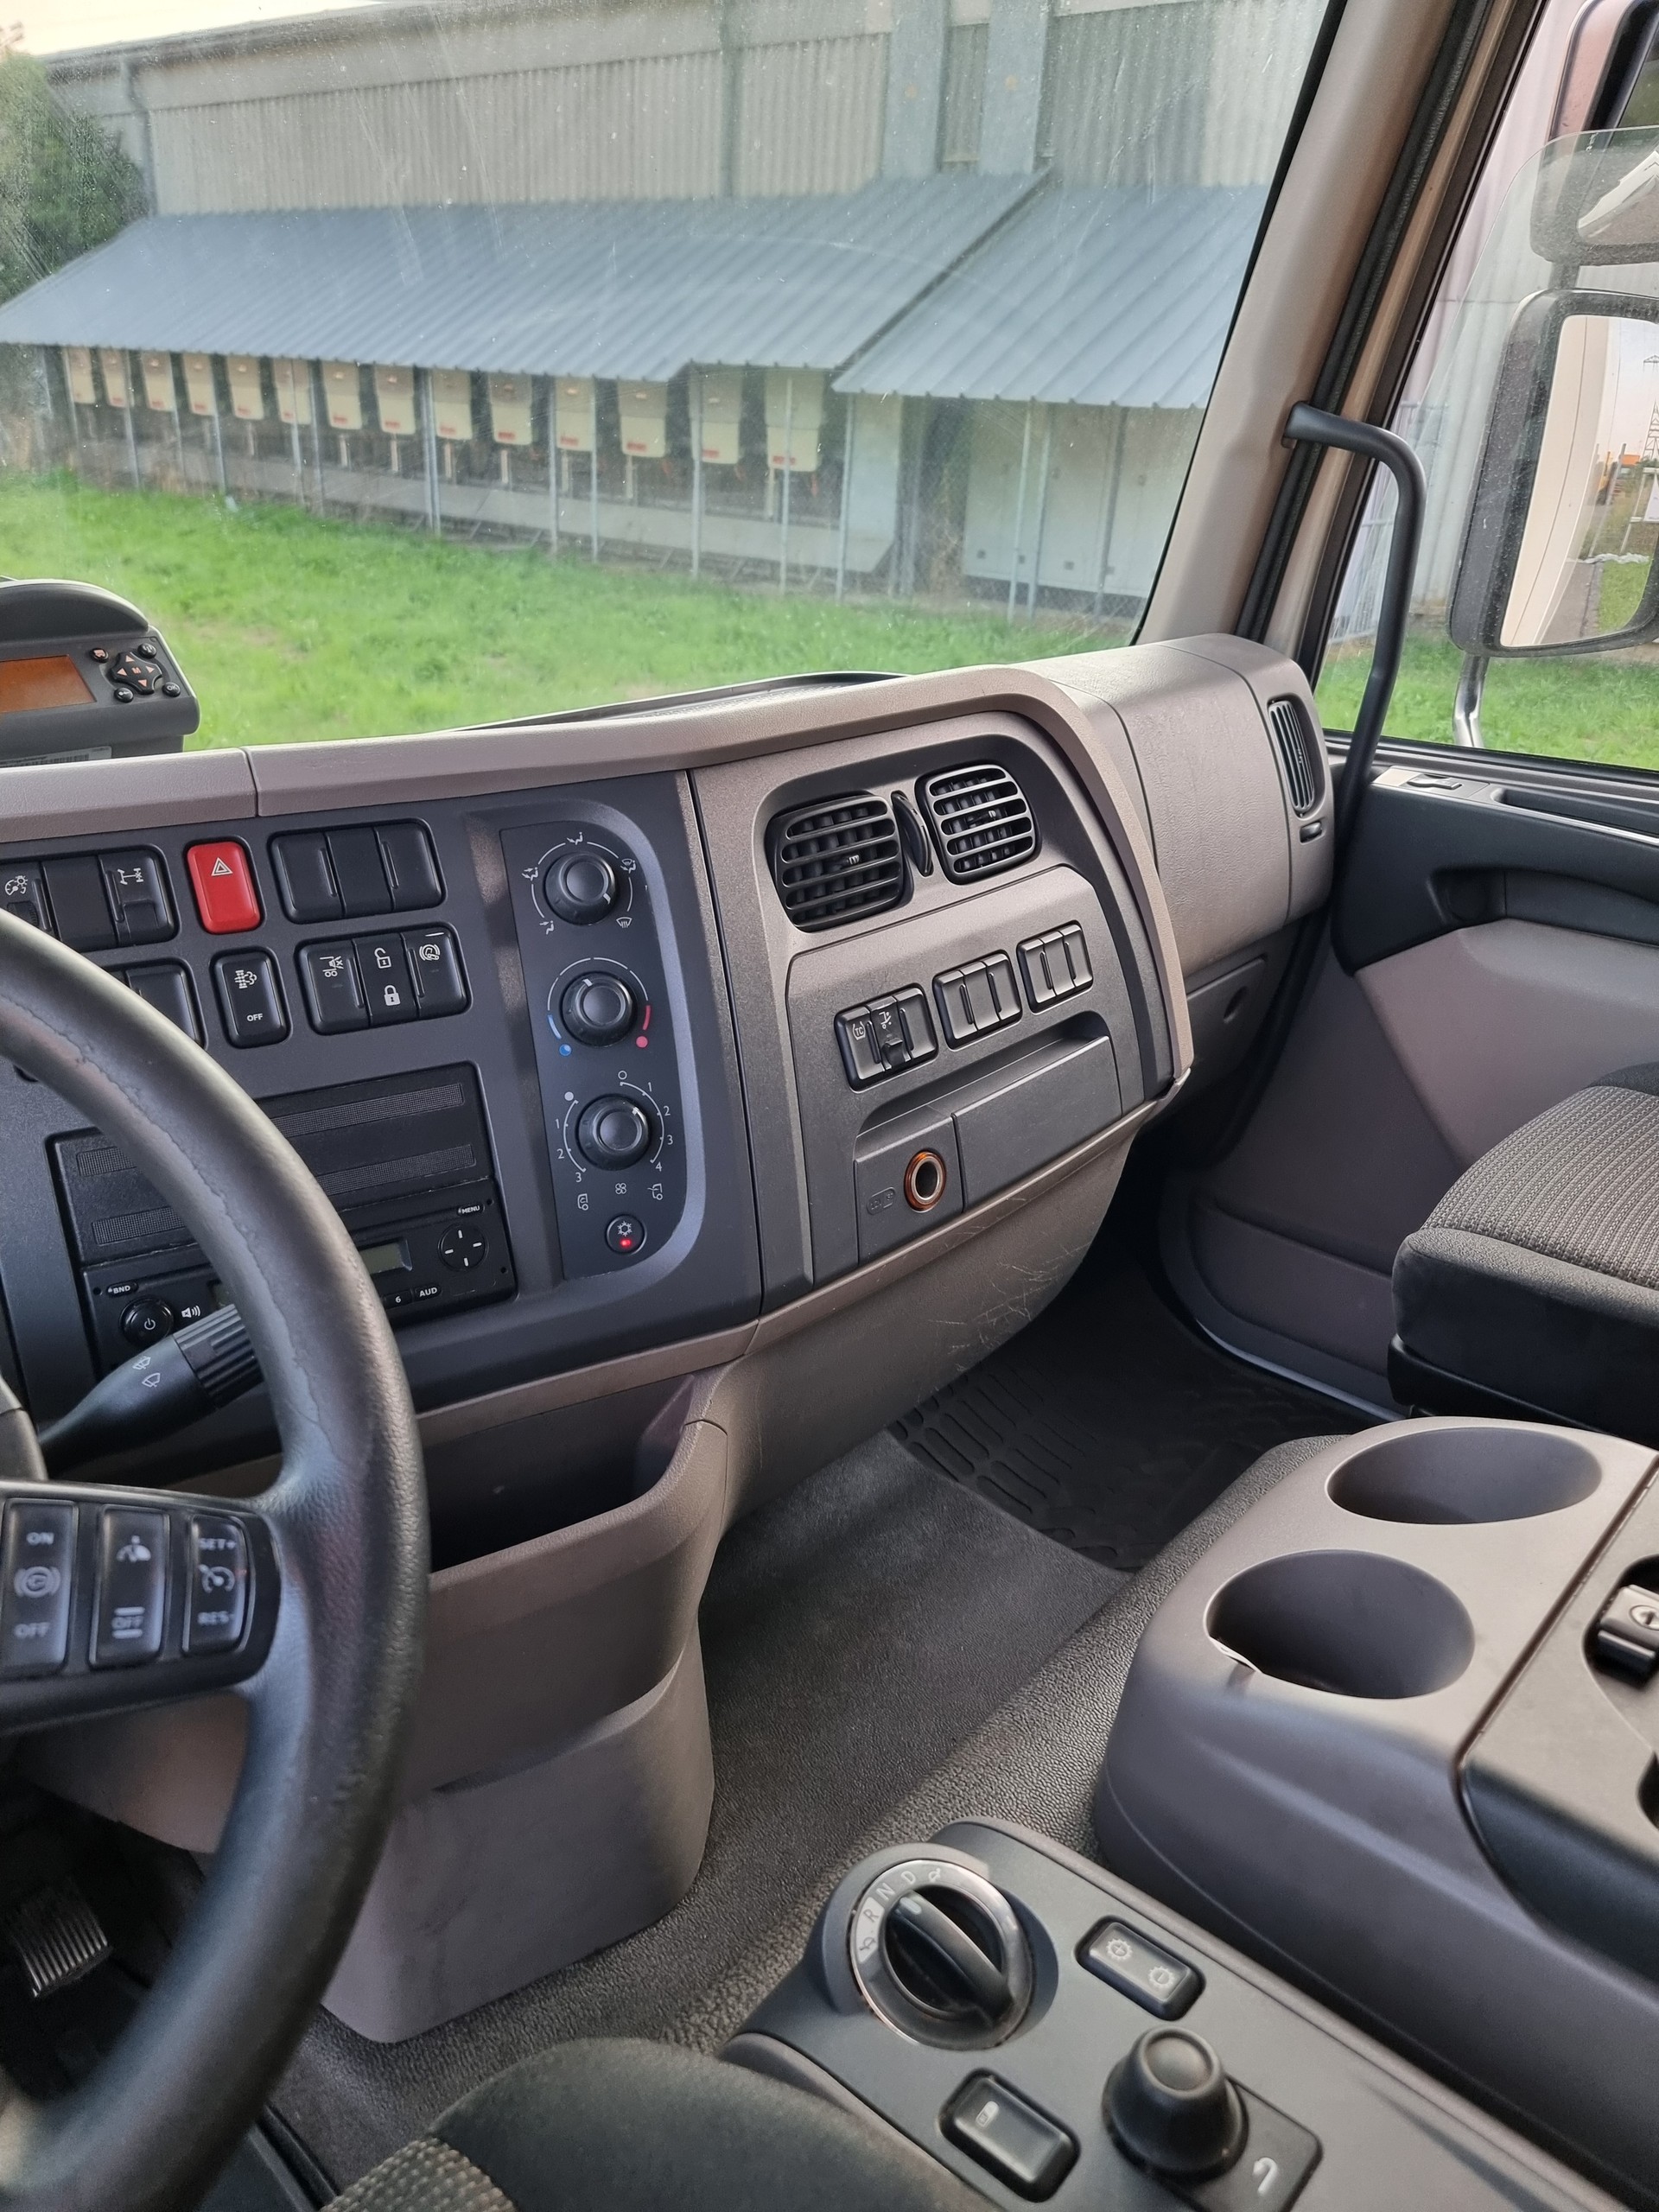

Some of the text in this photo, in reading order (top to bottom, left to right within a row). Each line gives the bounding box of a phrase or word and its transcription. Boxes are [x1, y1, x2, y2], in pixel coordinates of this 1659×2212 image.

[246, 1013, 264, 1022] OFF
[854, 1026, 864, 1037] TC
[647, 1081, 653, 1093] 1
[663, 1105, 671, 1116] 2
[554, 1118, 560, 1129] 1
[666, 1134, 674, 1146] 3
[556, 1147, 565, 1160] 2
[655, 1161, 663, 1173] 4
[575, 1172, 582, 1183] 3
[461, 1205, 481, 1215] MENU
[112, 1285, 130, 1294] BND
[418, 1286, 439, 1298] AUD
[394, 1295, 402, 1304] 6
[25, 1531, 54, 1546] ON
[13, 1621, 51, 1639] OFF
[899, 1870, 917, 1885] D
[875, 1882, 896, 1902] N
[863, 1908, 880, 1923] R
